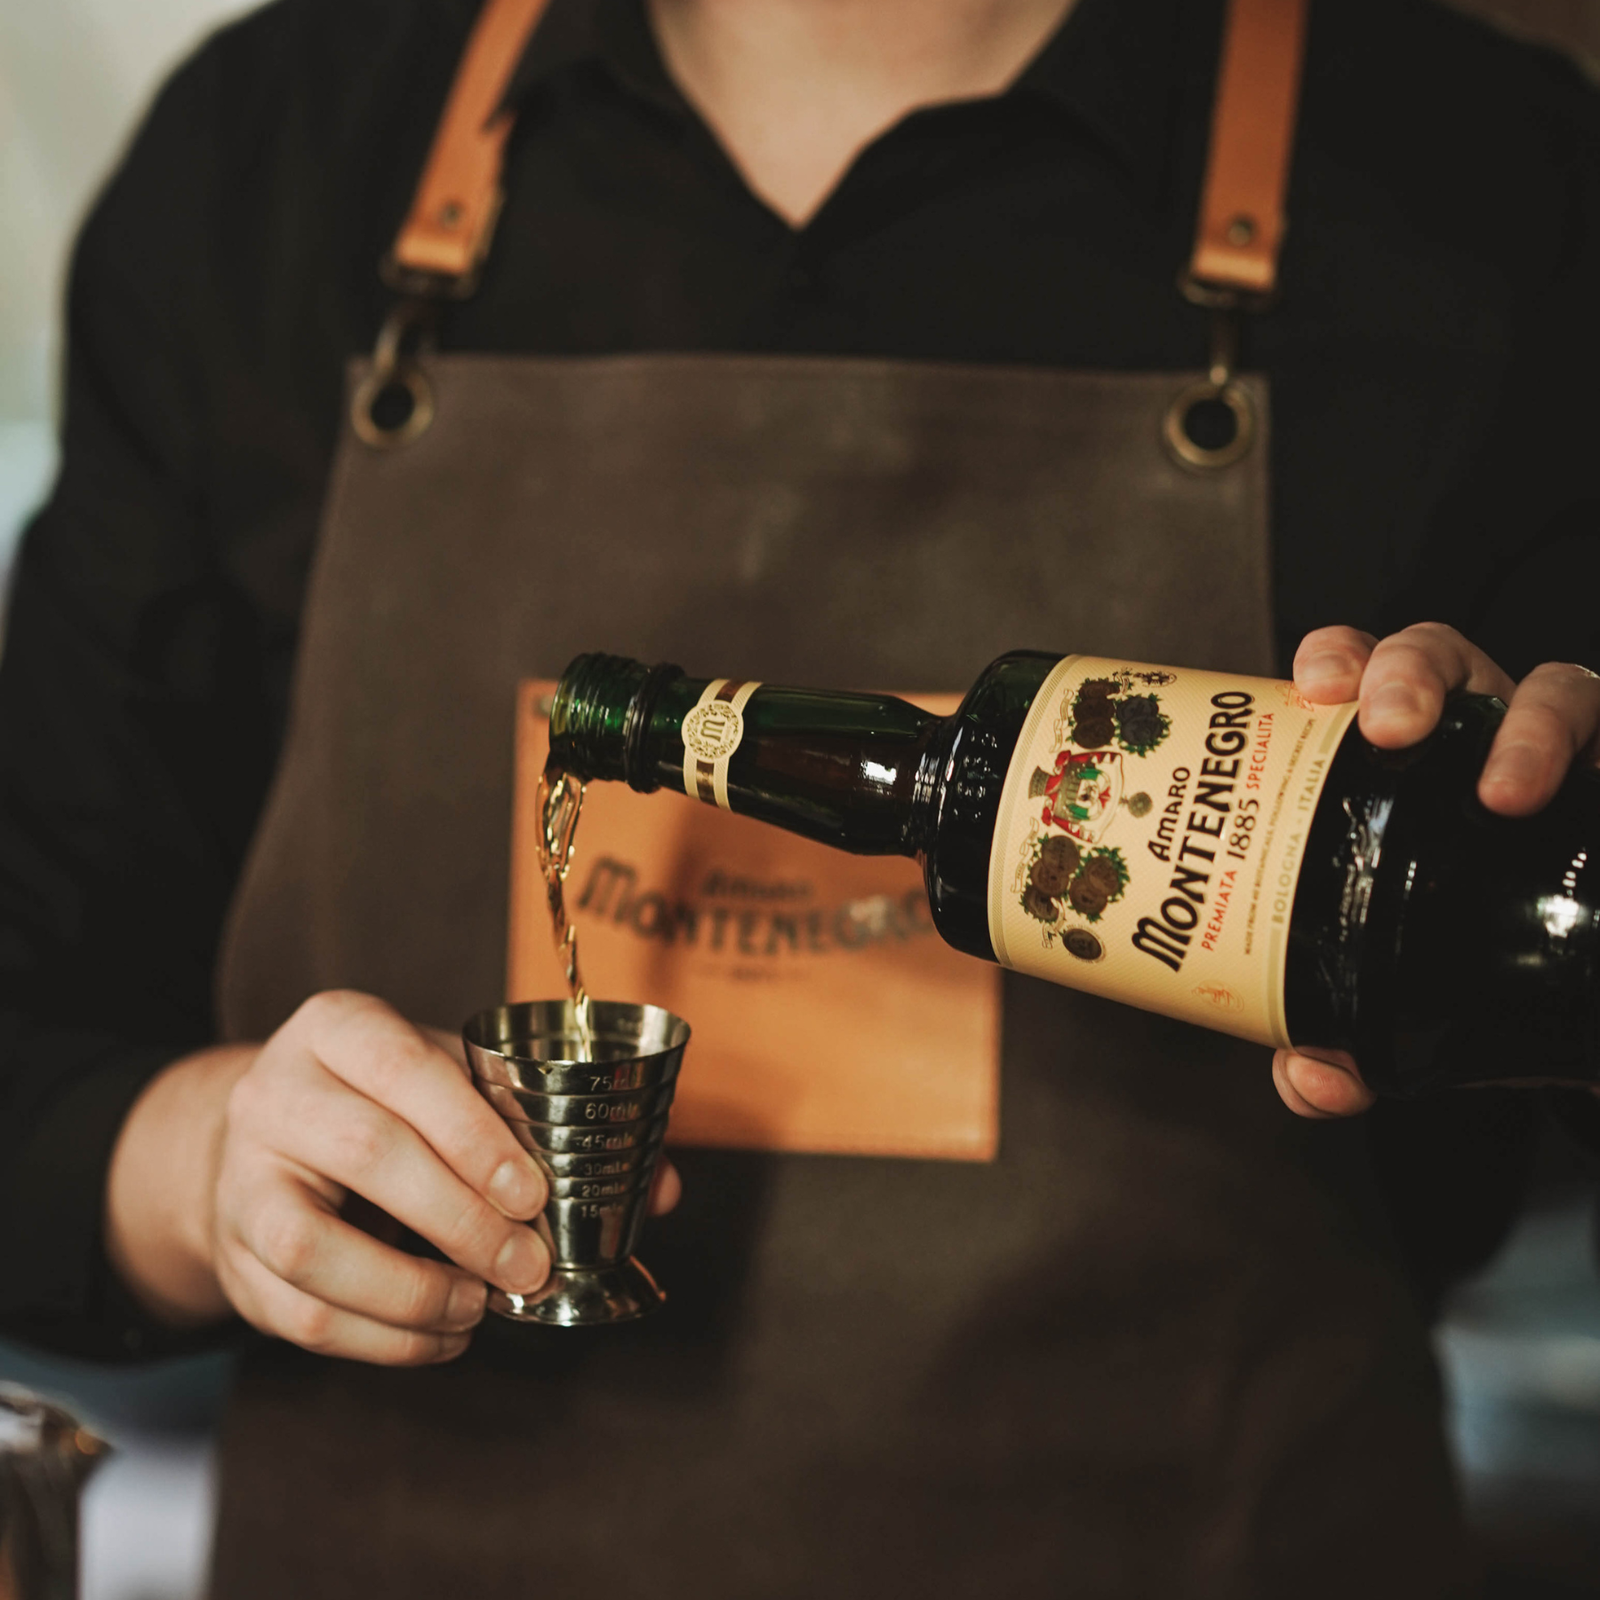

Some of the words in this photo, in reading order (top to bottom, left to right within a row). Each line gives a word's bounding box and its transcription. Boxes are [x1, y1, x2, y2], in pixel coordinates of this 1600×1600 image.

[1131, 691, 1255, 973] MONTENEGRO
[1201, 870, 1238, 952] PREMIATA
[1226, 798, 1260, 860] 1885
[1272, 833, 1302, 924] BOLOGNA
[1297, 759, 1326, 812] ITALIA
